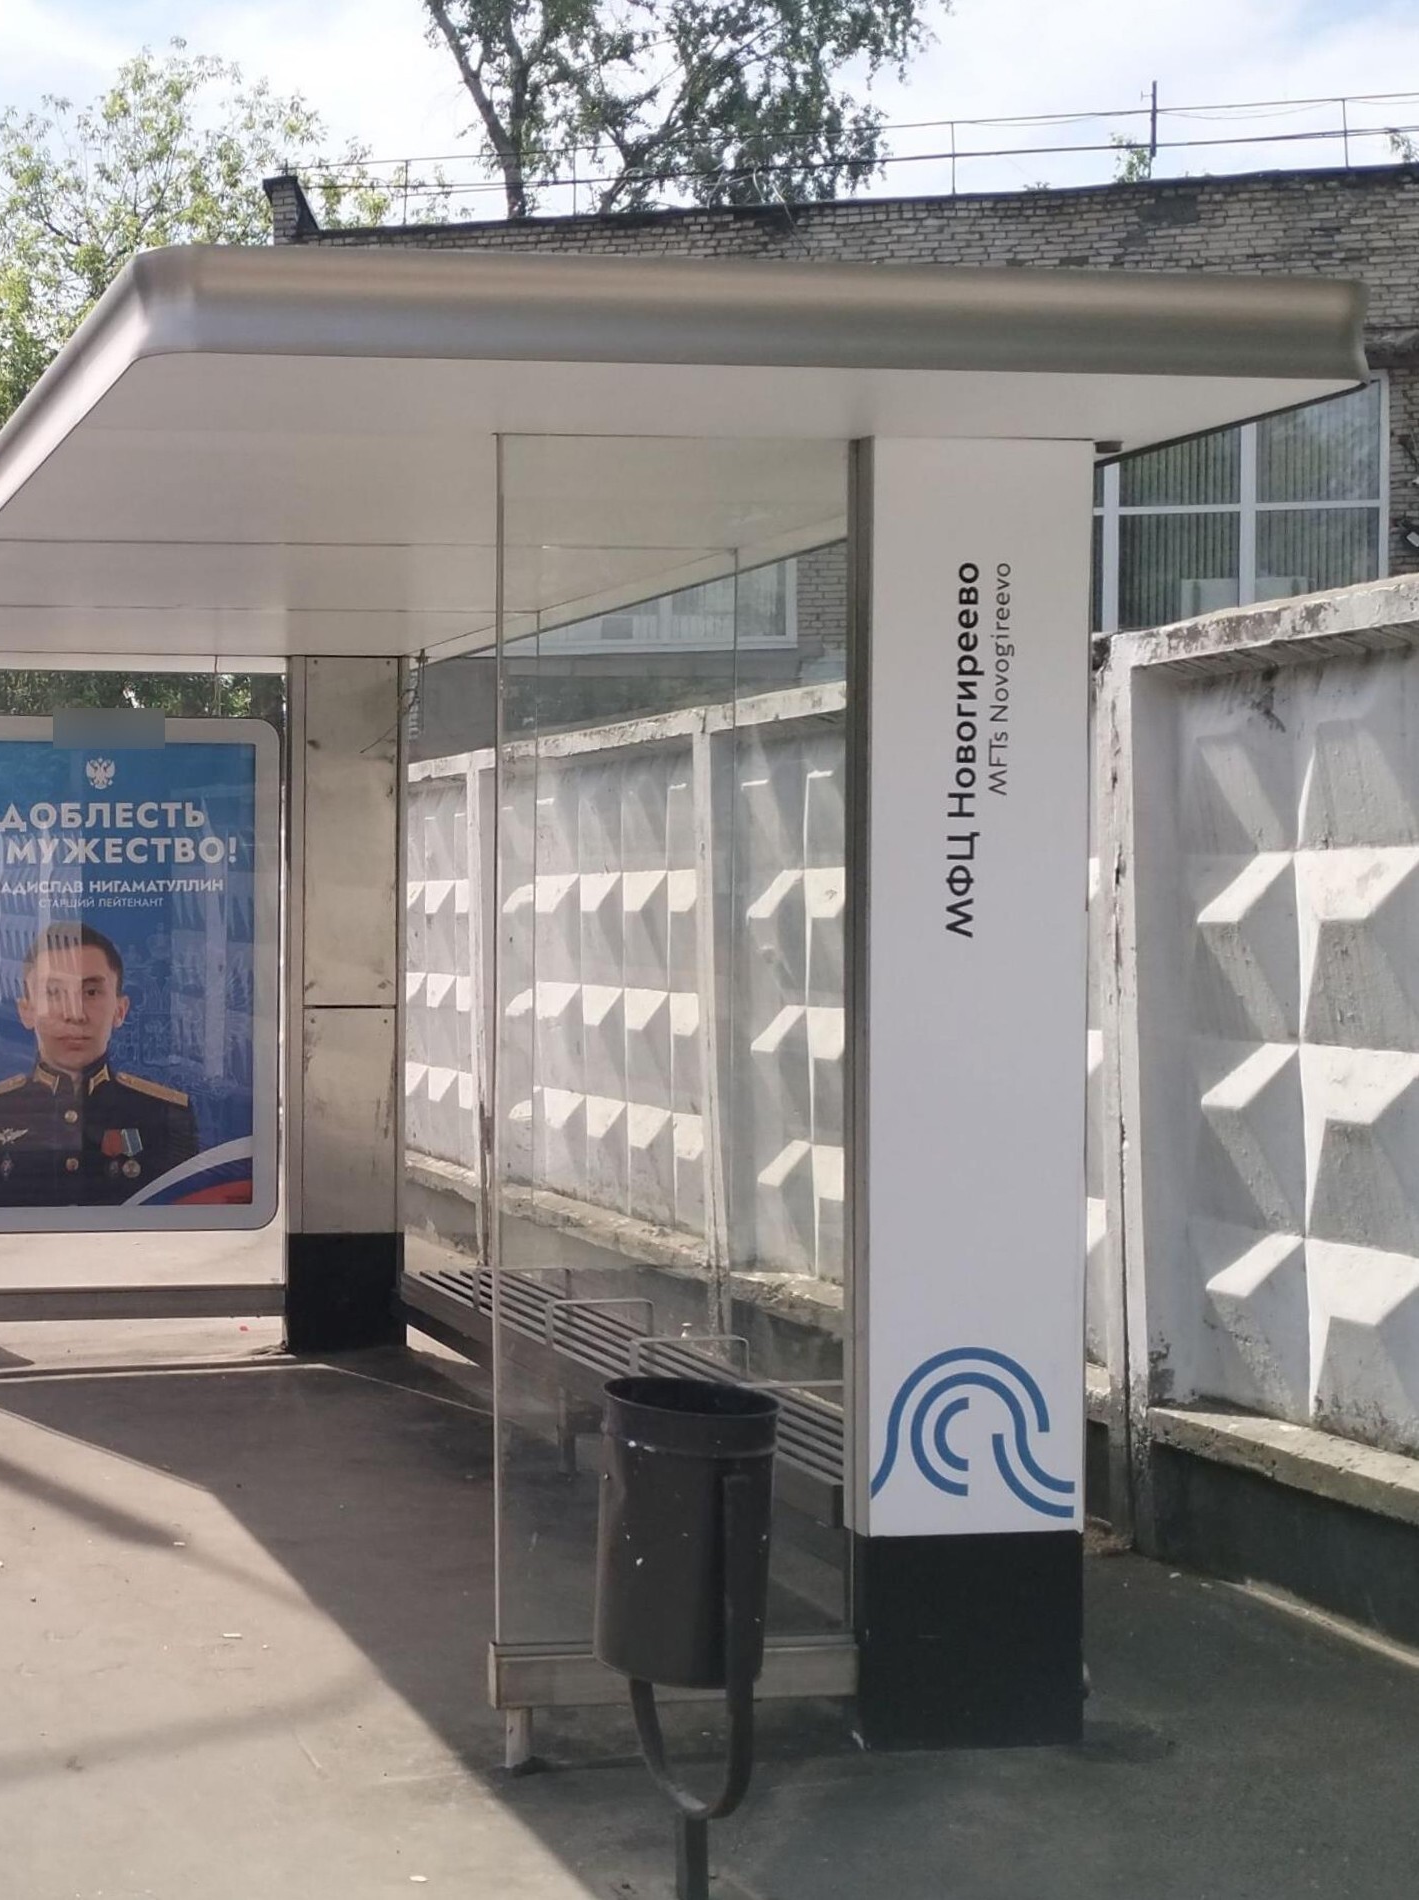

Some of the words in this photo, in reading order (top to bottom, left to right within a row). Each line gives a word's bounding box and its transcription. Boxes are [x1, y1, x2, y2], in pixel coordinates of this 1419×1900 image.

[990, 562, 1015, 722] Novogireevo
[947, 562, 985, 818] Новогиреево
[988, 731, 1009, 796] MFTs
[6, 836, 238, 864] МУЖЕСТВО!
[39, 897, 95, 908] СТАРШИЙ
[99, 897, 163, 908] ЛЕЙТЕНАНТ
[89, 879, 224, 893] НИГАМАТУЛЛИН
[945, 832, 981, 938] МФЦ
